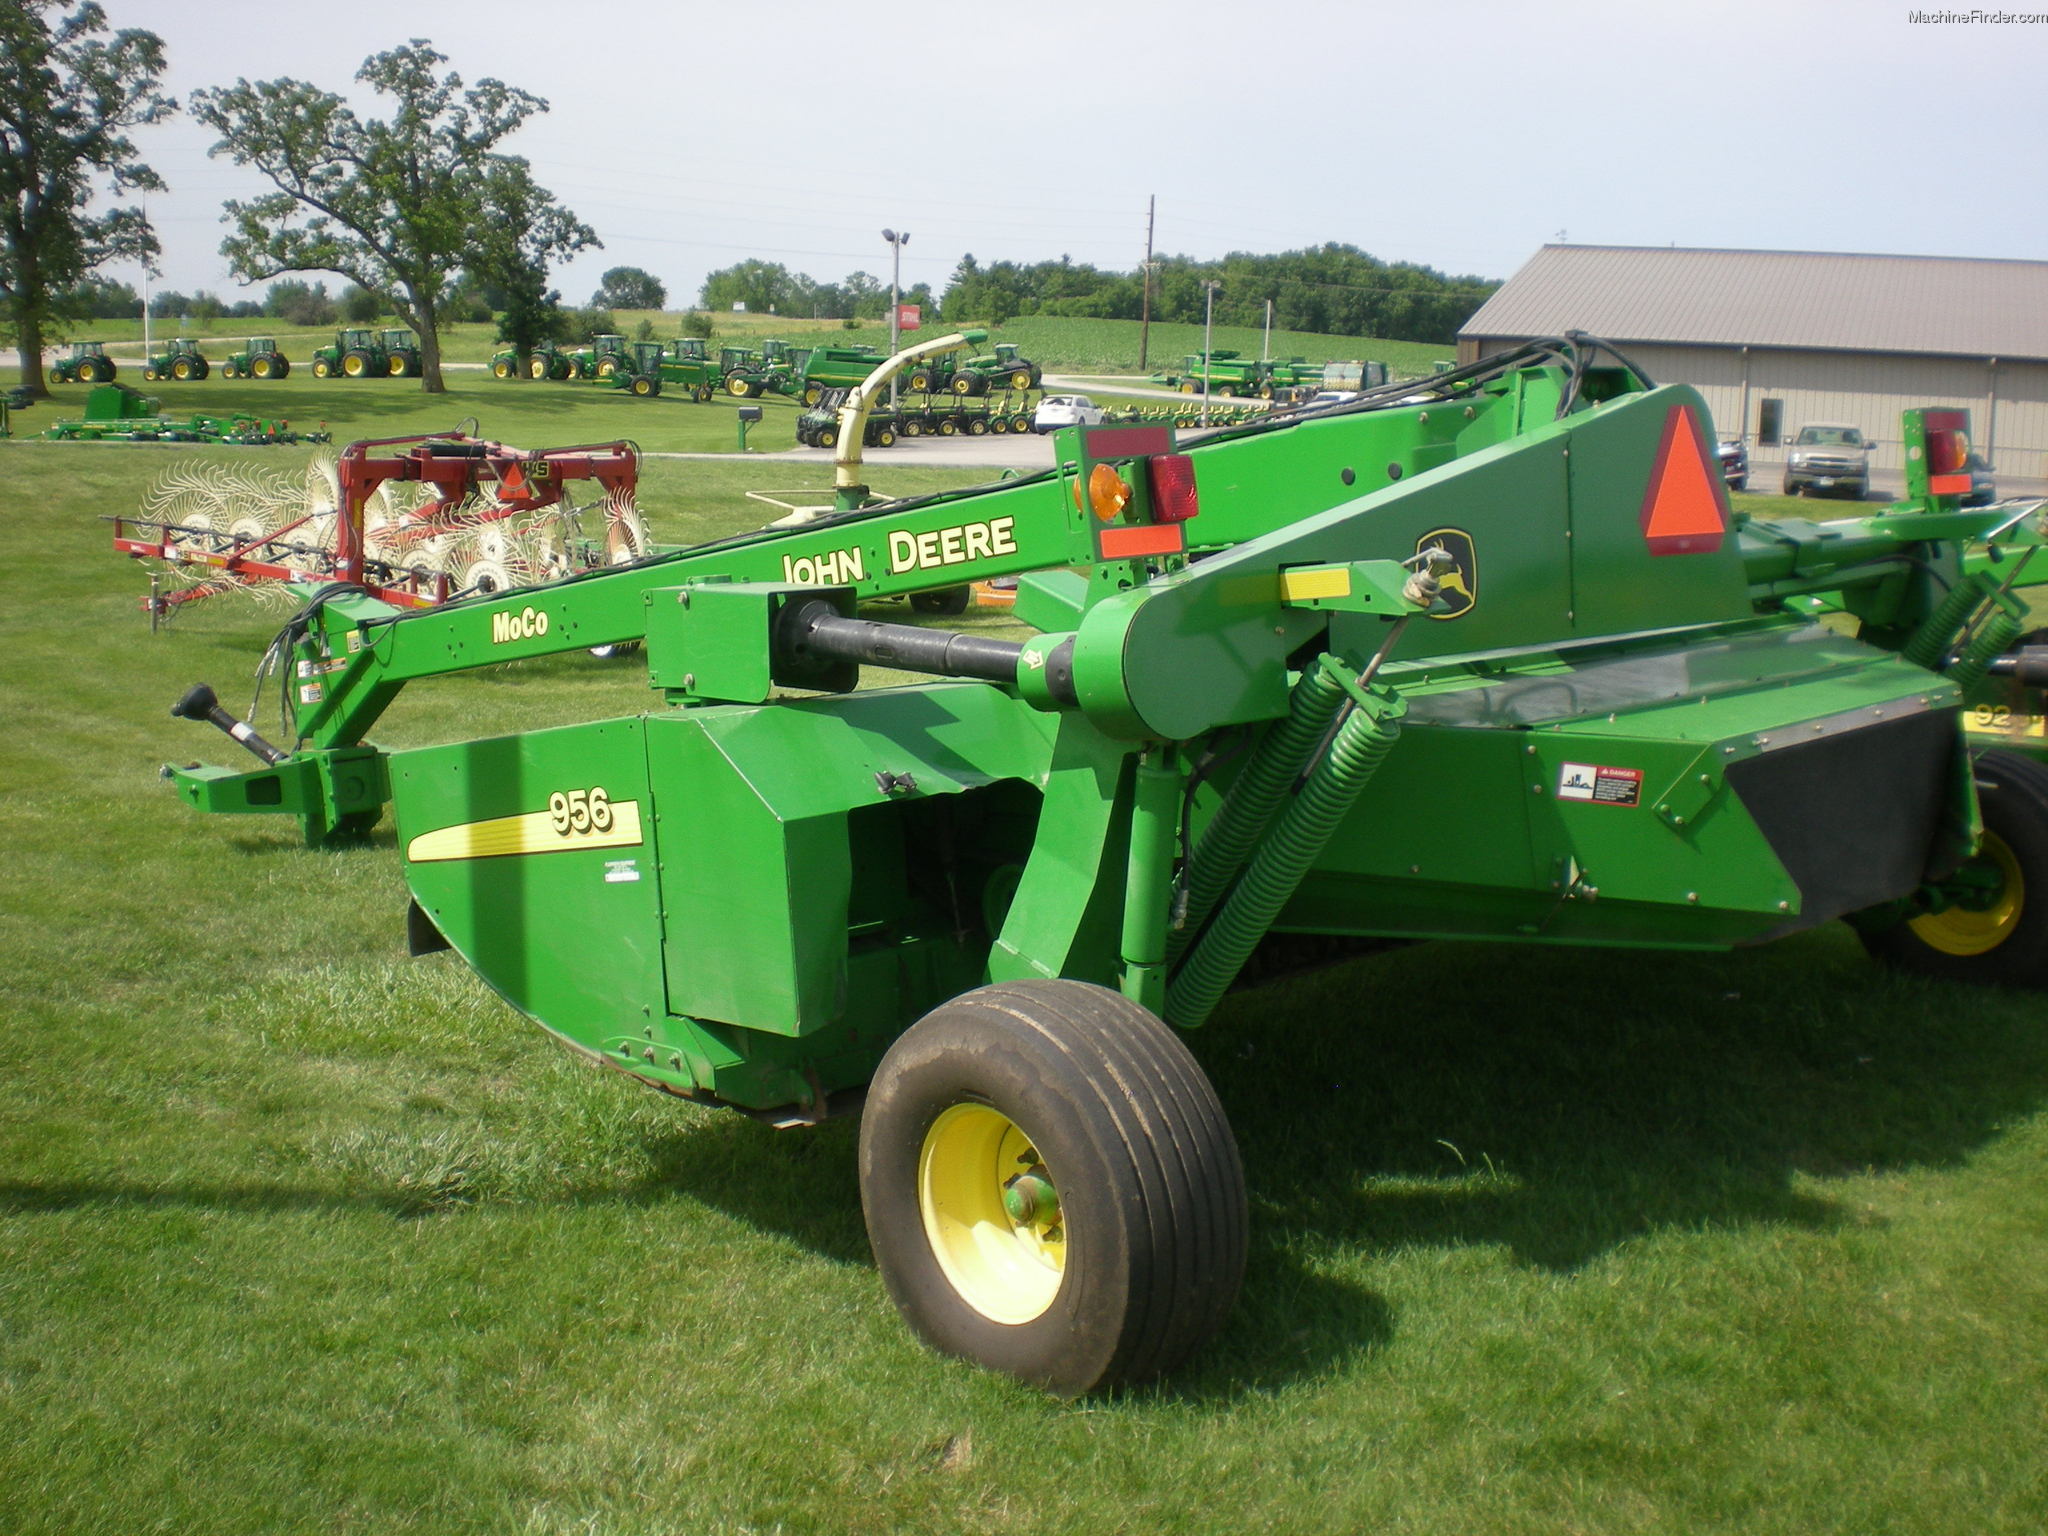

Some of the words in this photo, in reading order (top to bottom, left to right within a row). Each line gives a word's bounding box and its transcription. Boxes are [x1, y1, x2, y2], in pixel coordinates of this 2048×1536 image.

[782, 546, 865, 586] JOHN
[888, 515, 1018, 575] DEERE
[492, 606, 549, 644] MoCo
[549, 785, 614, 836] 956
